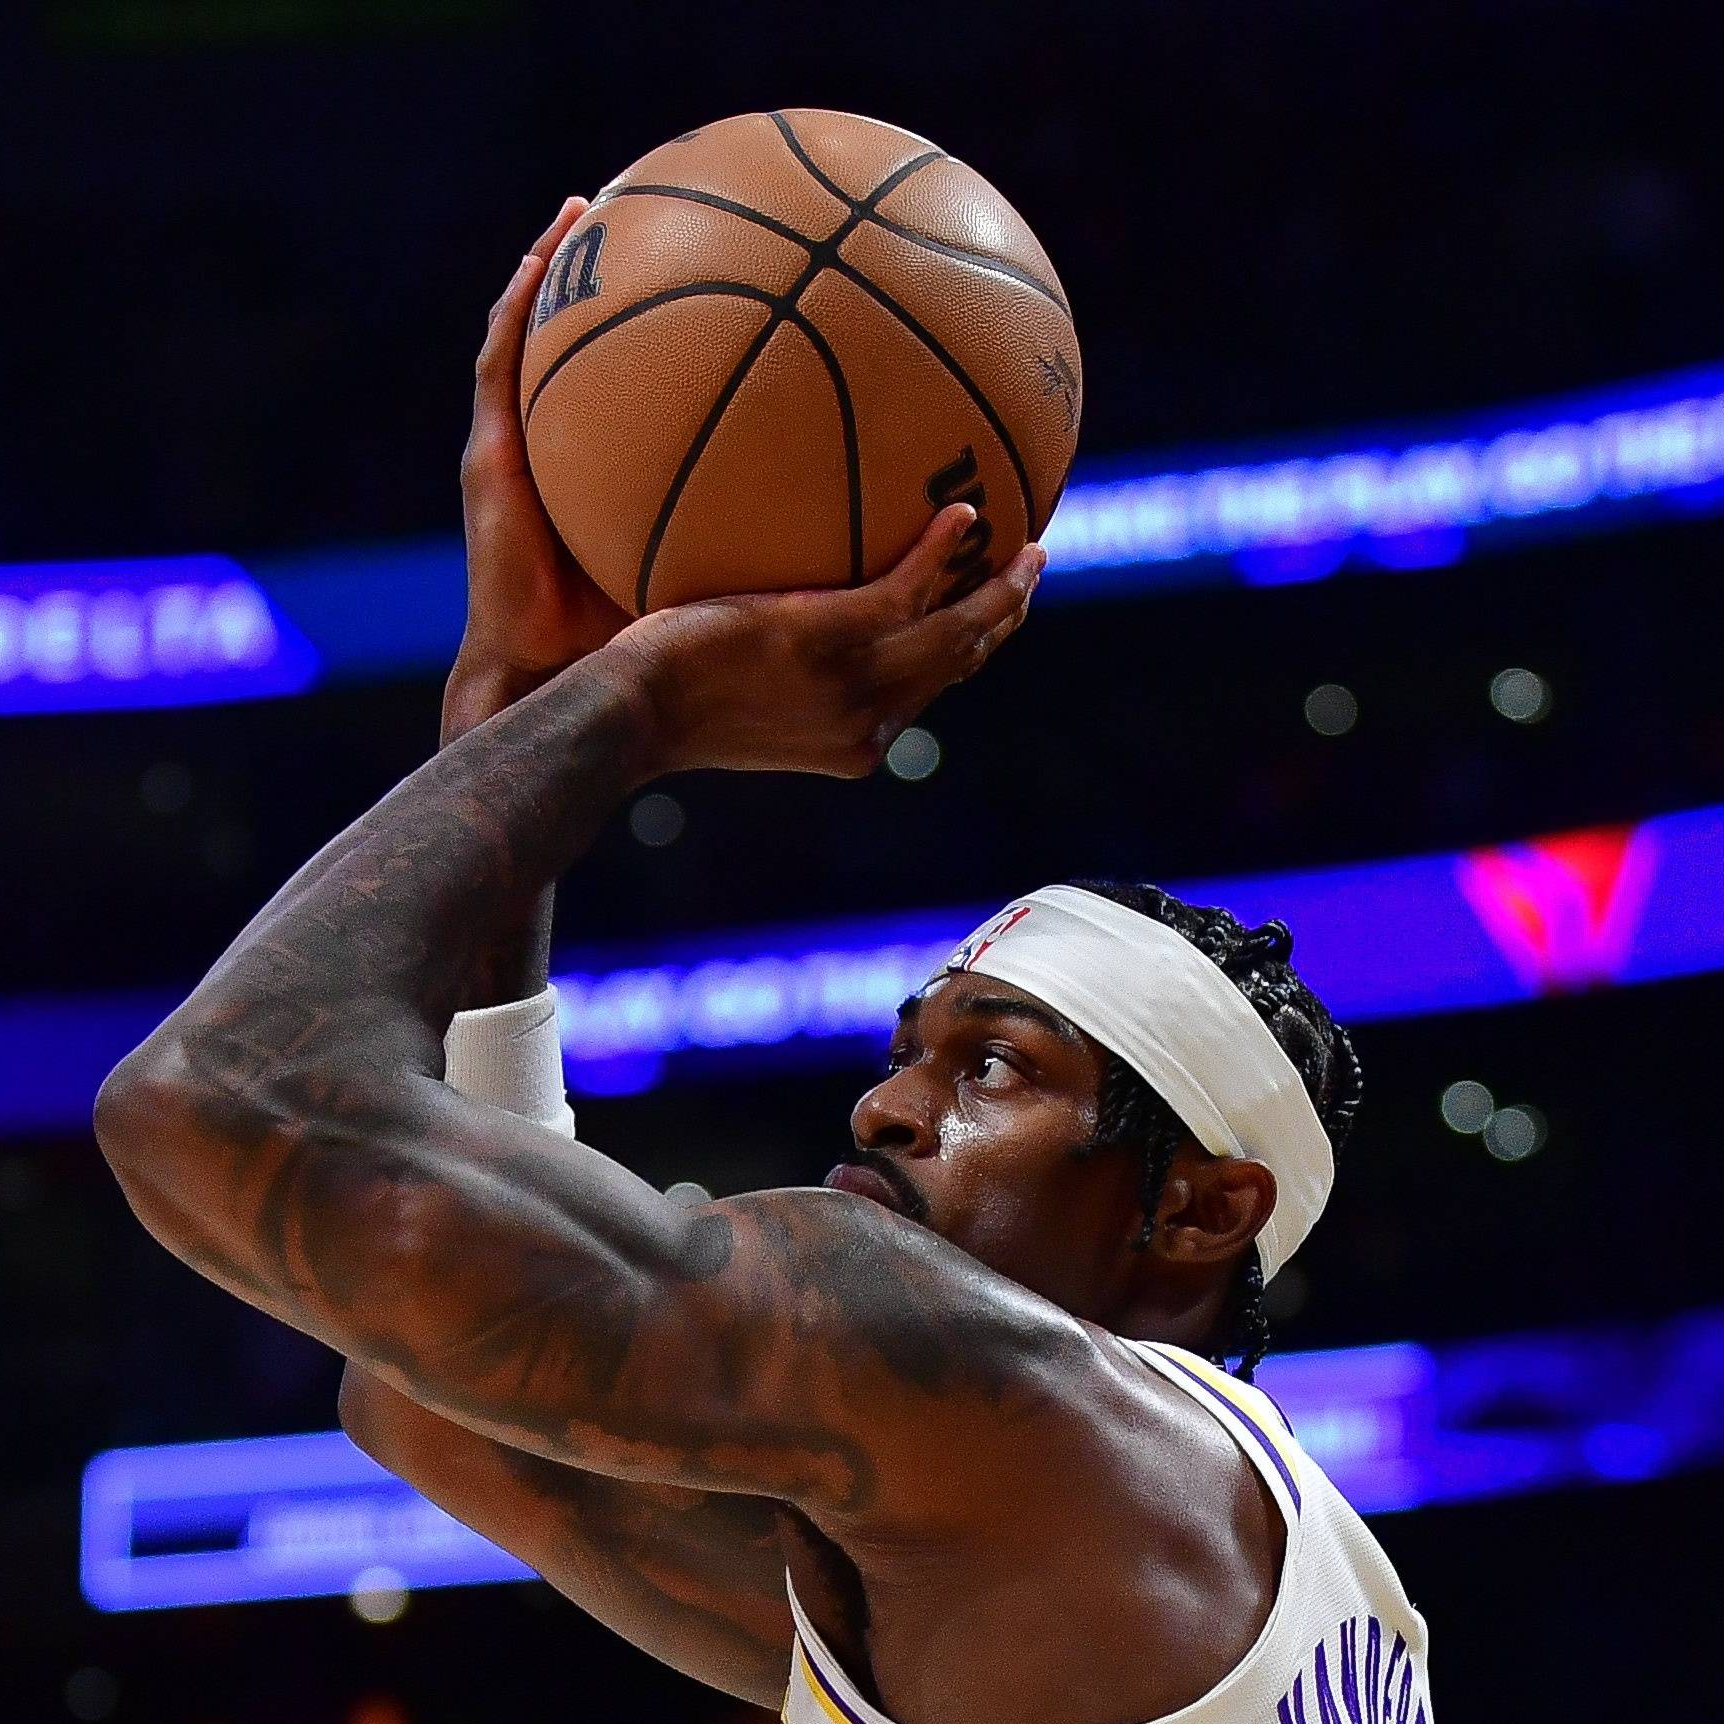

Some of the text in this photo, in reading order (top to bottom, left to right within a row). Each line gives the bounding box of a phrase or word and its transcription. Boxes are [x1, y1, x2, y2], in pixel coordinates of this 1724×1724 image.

[1194, 460, 1319, 557] THE
[1488, 424, 1595, 512] GO
[1597, 402, 1711, 495] THE
